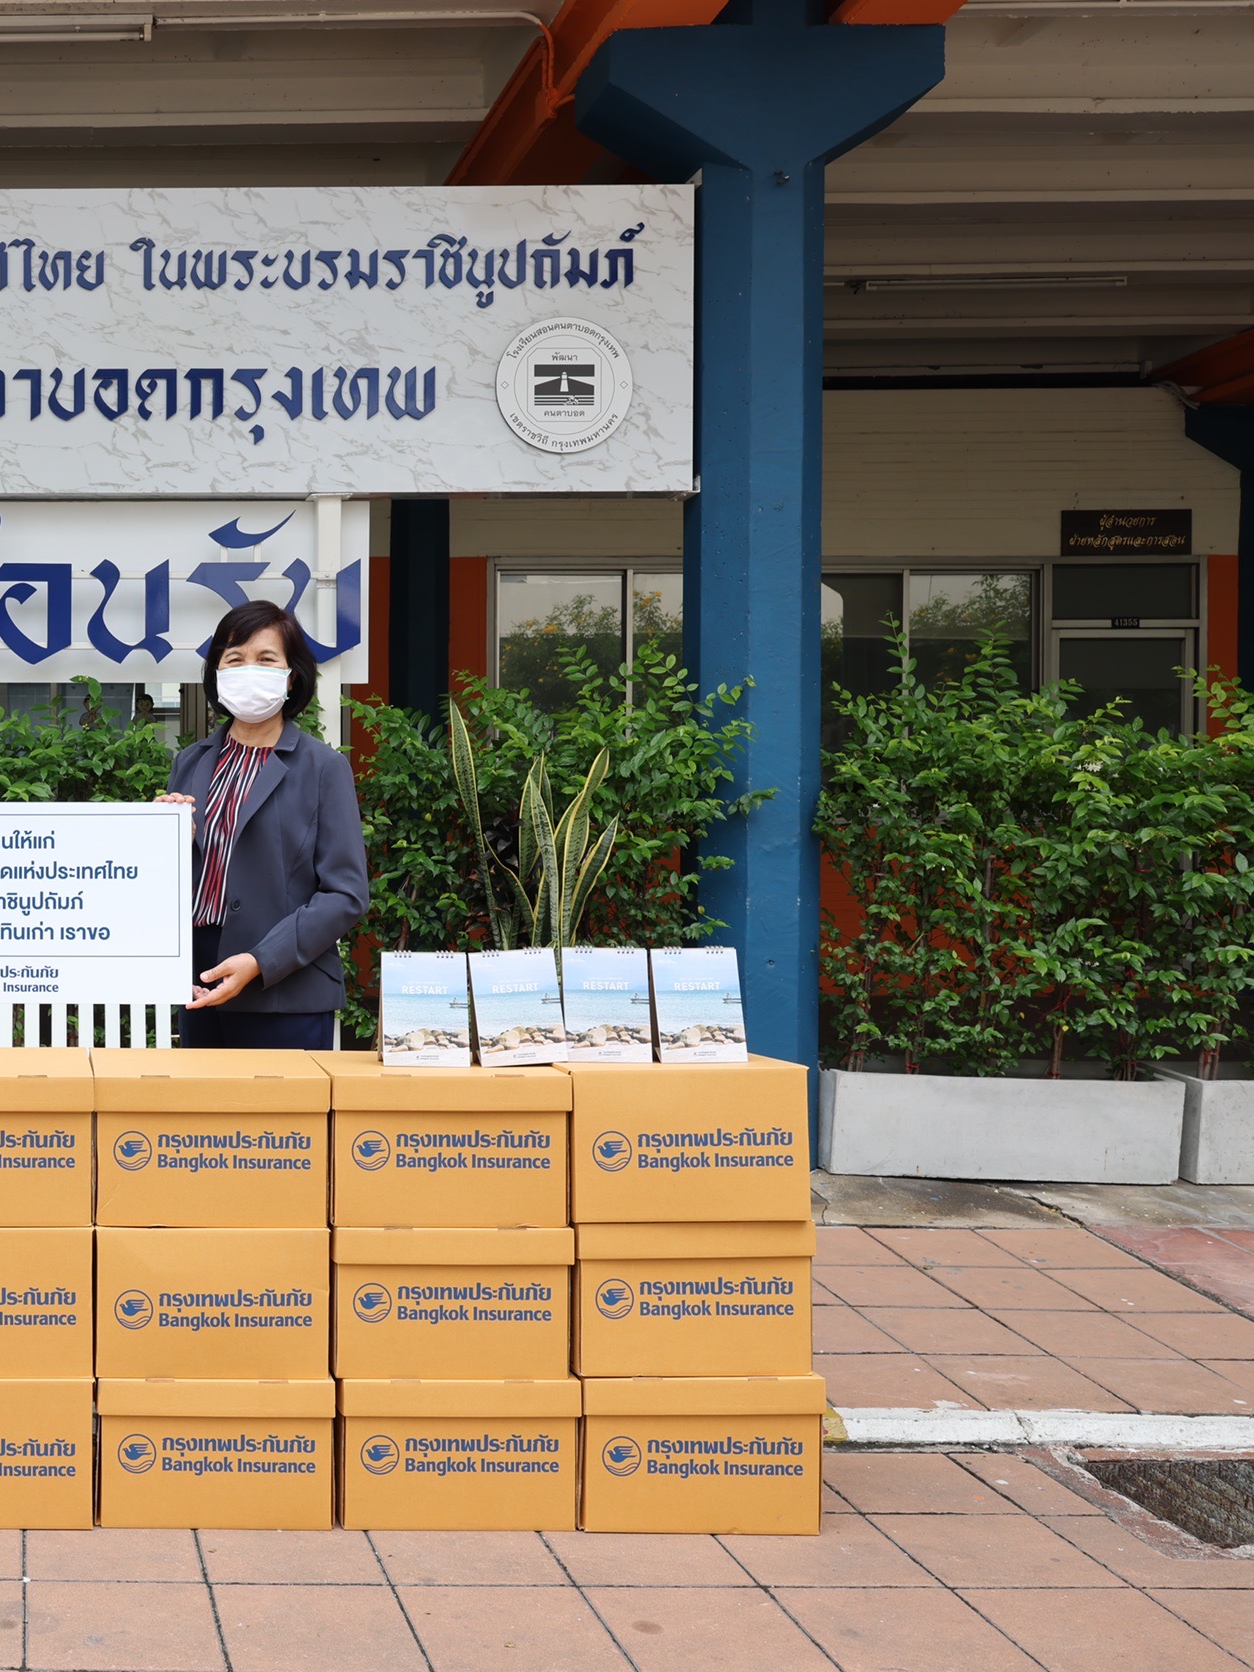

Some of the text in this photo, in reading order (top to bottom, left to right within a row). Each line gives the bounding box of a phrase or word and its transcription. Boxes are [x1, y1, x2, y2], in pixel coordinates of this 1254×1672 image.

[129, 221, 646, 310] ในพระบรมราชินูปถัมภ์
[506, 322, 620, 359] โรงเรียนสอนคนตาบอดกรุงเทพ
[551, 351, 578, 361] พัฒนา
[551, 413, 619, 451] กรุงเทพมหานคร
[1099, 513, 1157, 531] ผู้อำนวยการ
[60, 927, 111, 941] เราขอ
[3, 982, 59, 992] Insurance
[401, 985, 449, 995] RESTART
[491, 982, 539, 994] RESTART
[582, 981, 629, 991] RESTART
[674, 981, 721, 991] RESTART
[158, 1131, 309, 1155] กรุงเทพประกันภัย
[397, 1130, 549, 1154] กรุงเทพประกันภัย
[638, 1127, 792, 1152] กรุงเทพประกันภัย
[158, 1152, 310, 1172] Bangkok Insurance
[397, 1152, 550, 1172] Bangkok Insurance
[638, 1152, 793, 1172] Bangkok Insurance
[398, 1283, 550, 1307] กรุงเทพประกันภัย
[640, 1277, 793, 1302] กรุงเทพประกันภัย
[160, 1289, 311, 1313] กรุงเทพประกันภัย
[640, 1300, 794, 1320] Bangkok Insurance
[0, 1310, 76, 1325] Insurance
[160, 1310, 312, 1330] Bangkok Insurance
[398, 1304, 551, 1324] Bangkok Insurance
[163, 1435, 314, 1459] กรุงเทพประกันภัย
[406, 1435, 558, 1459] กรุงเทพประกันภัย
[648, 1437, 801, 1461] กรุงเทพประกันภัย
[163, 1455, 315, 1475] Bangkok Insurance
[406, 1455, 559, 1475] Bangkok Insurance
[648, 1458, 802, 1478] Bangkok Insurance
